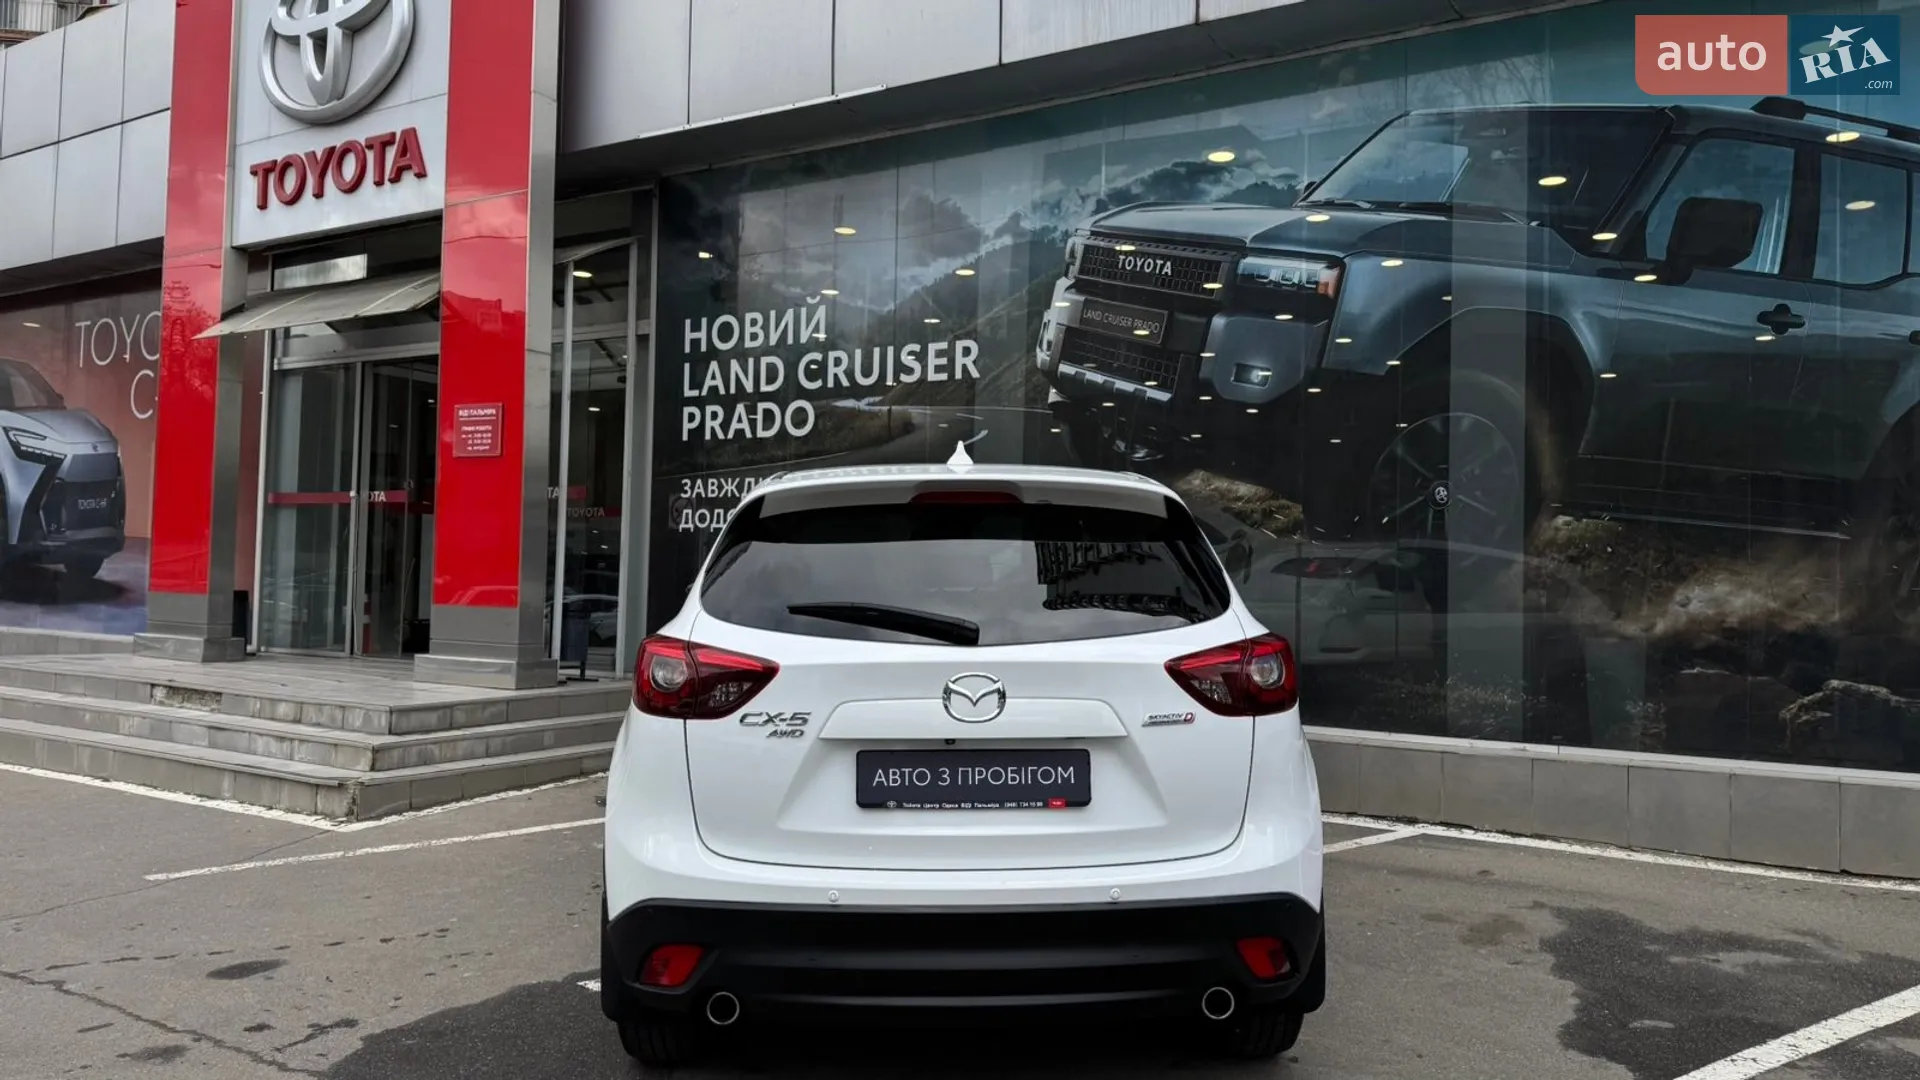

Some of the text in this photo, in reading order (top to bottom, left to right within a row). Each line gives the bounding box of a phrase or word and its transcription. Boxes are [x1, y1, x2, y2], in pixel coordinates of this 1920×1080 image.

[250, 127, 427, 210] TOYOTA
[1118, 255, 1172, 275] TOYOTA
[684, 296, 827, 353] НОВИЙ
[1083, 308, 1160, 334] LAND CRUISER PRADO
[683, 340, 980, 397] LAND CRUISER
[682, 400, 815, 441] PRADO
[567, 506, 605, 517] TOYOTA
[739, 711, 812, 727] CX-5
[766, 728, 805, 738] AWD
[872, 767, 931, 787] АВТО
[958, 766, 1075, 785] ПРОБІГОМ
